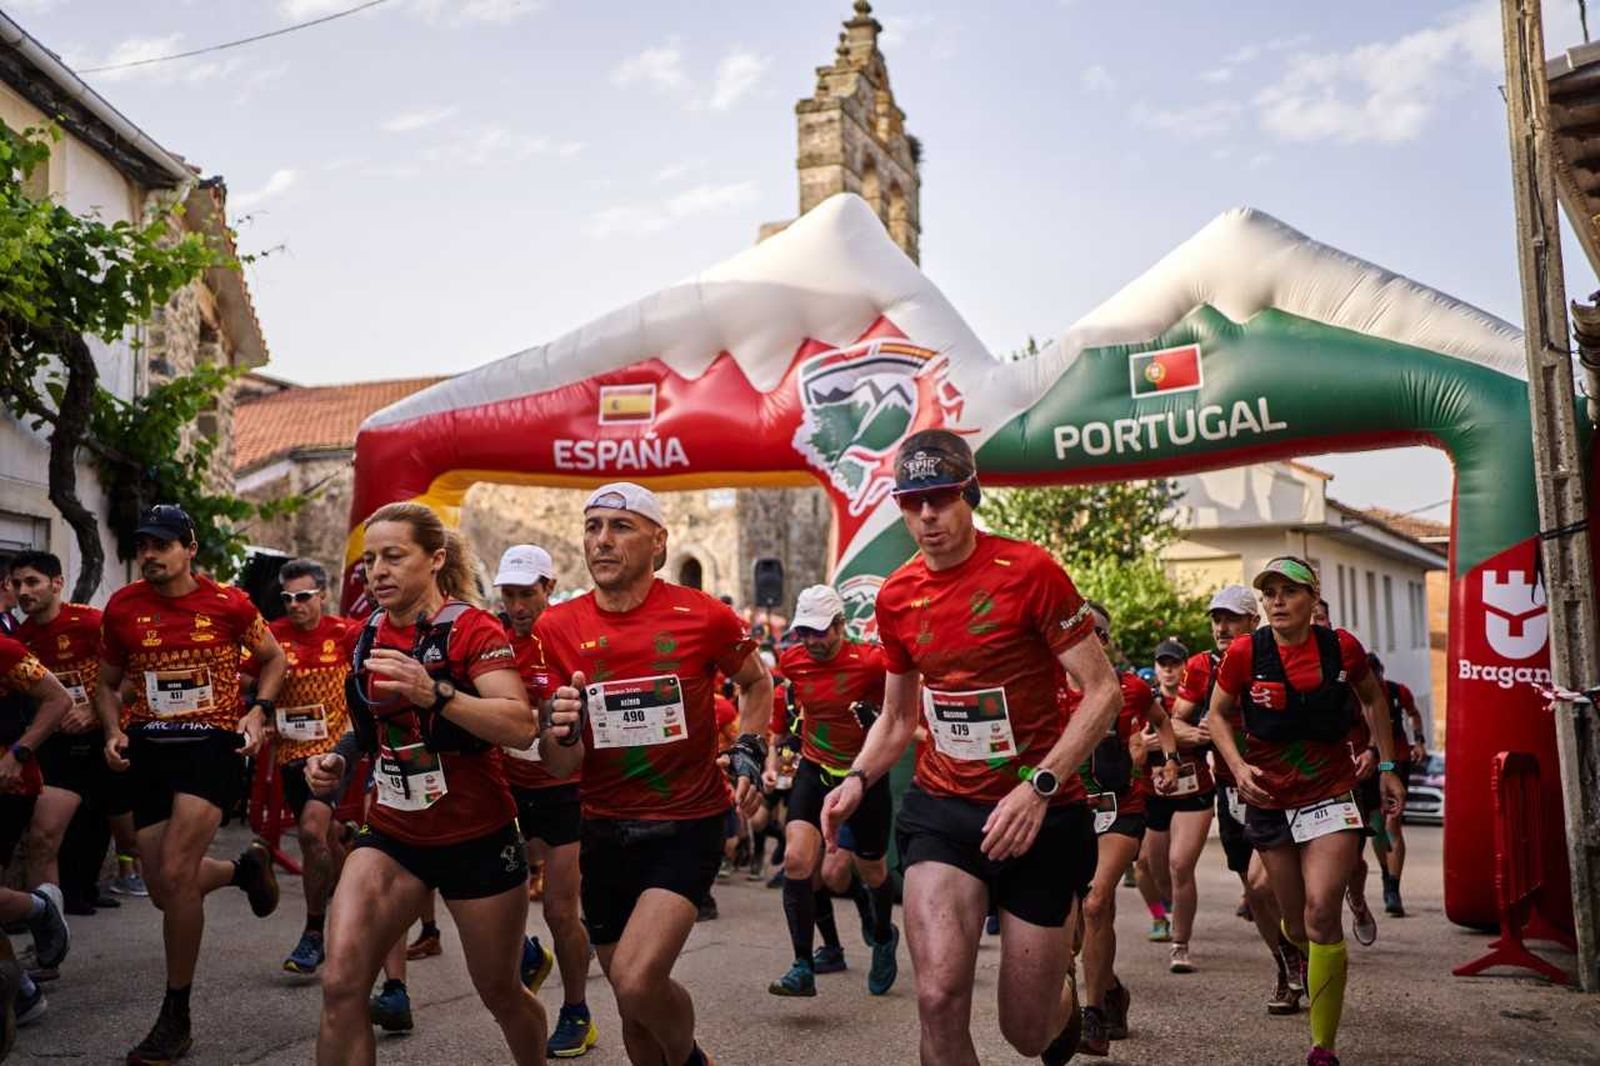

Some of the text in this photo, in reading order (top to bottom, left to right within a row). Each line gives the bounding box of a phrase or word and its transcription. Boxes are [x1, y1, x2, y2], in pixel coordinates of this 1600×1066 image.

[1053, 397, 1287, 460] PORTUGAL
[553, 431, 690, 470] ESPAÑA
[623, 710, 645, 723] 490
[951, 723, 970, 736] 479
